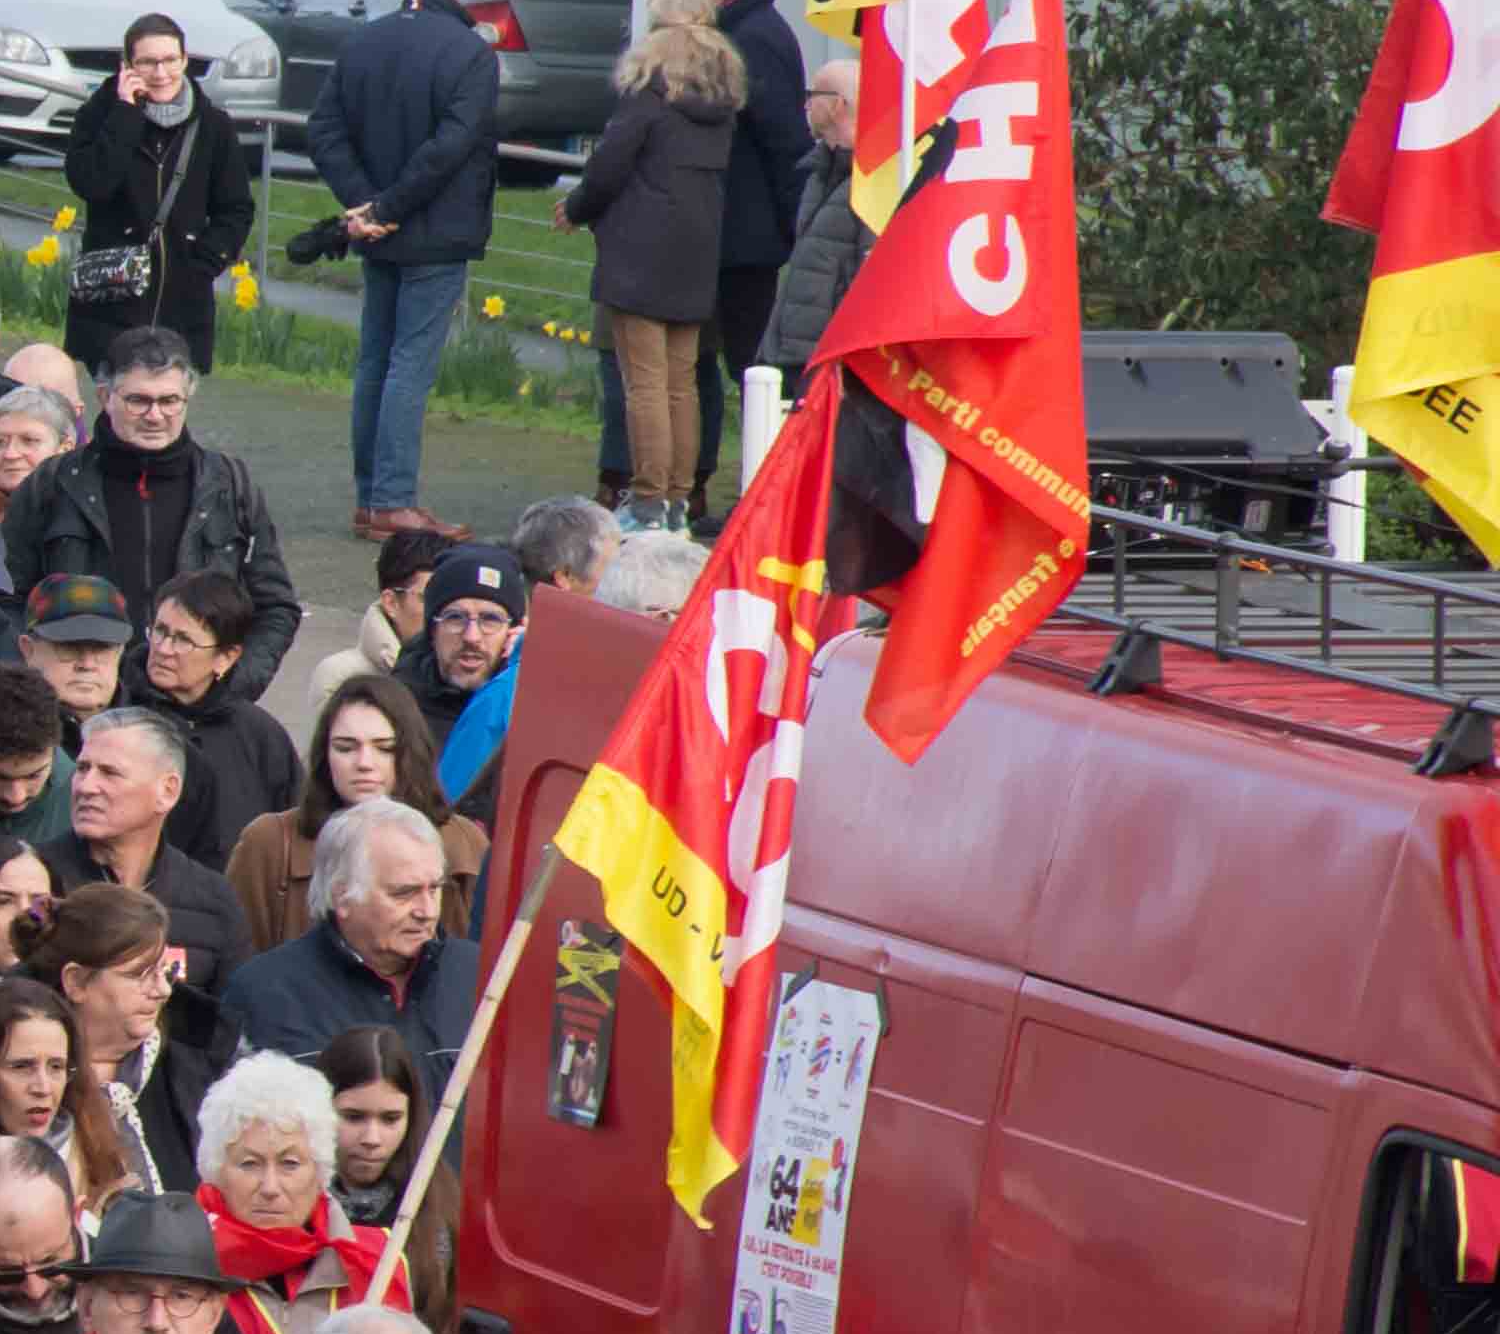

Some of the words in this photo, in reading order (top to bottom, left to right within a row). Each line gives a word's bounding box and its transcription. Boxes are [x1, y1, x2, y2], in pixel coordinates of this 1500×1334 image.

[908, 369, 979, 432] Parti
[652, 864, 687, 917] UD
[771, 1155, 801, 1201] 64
